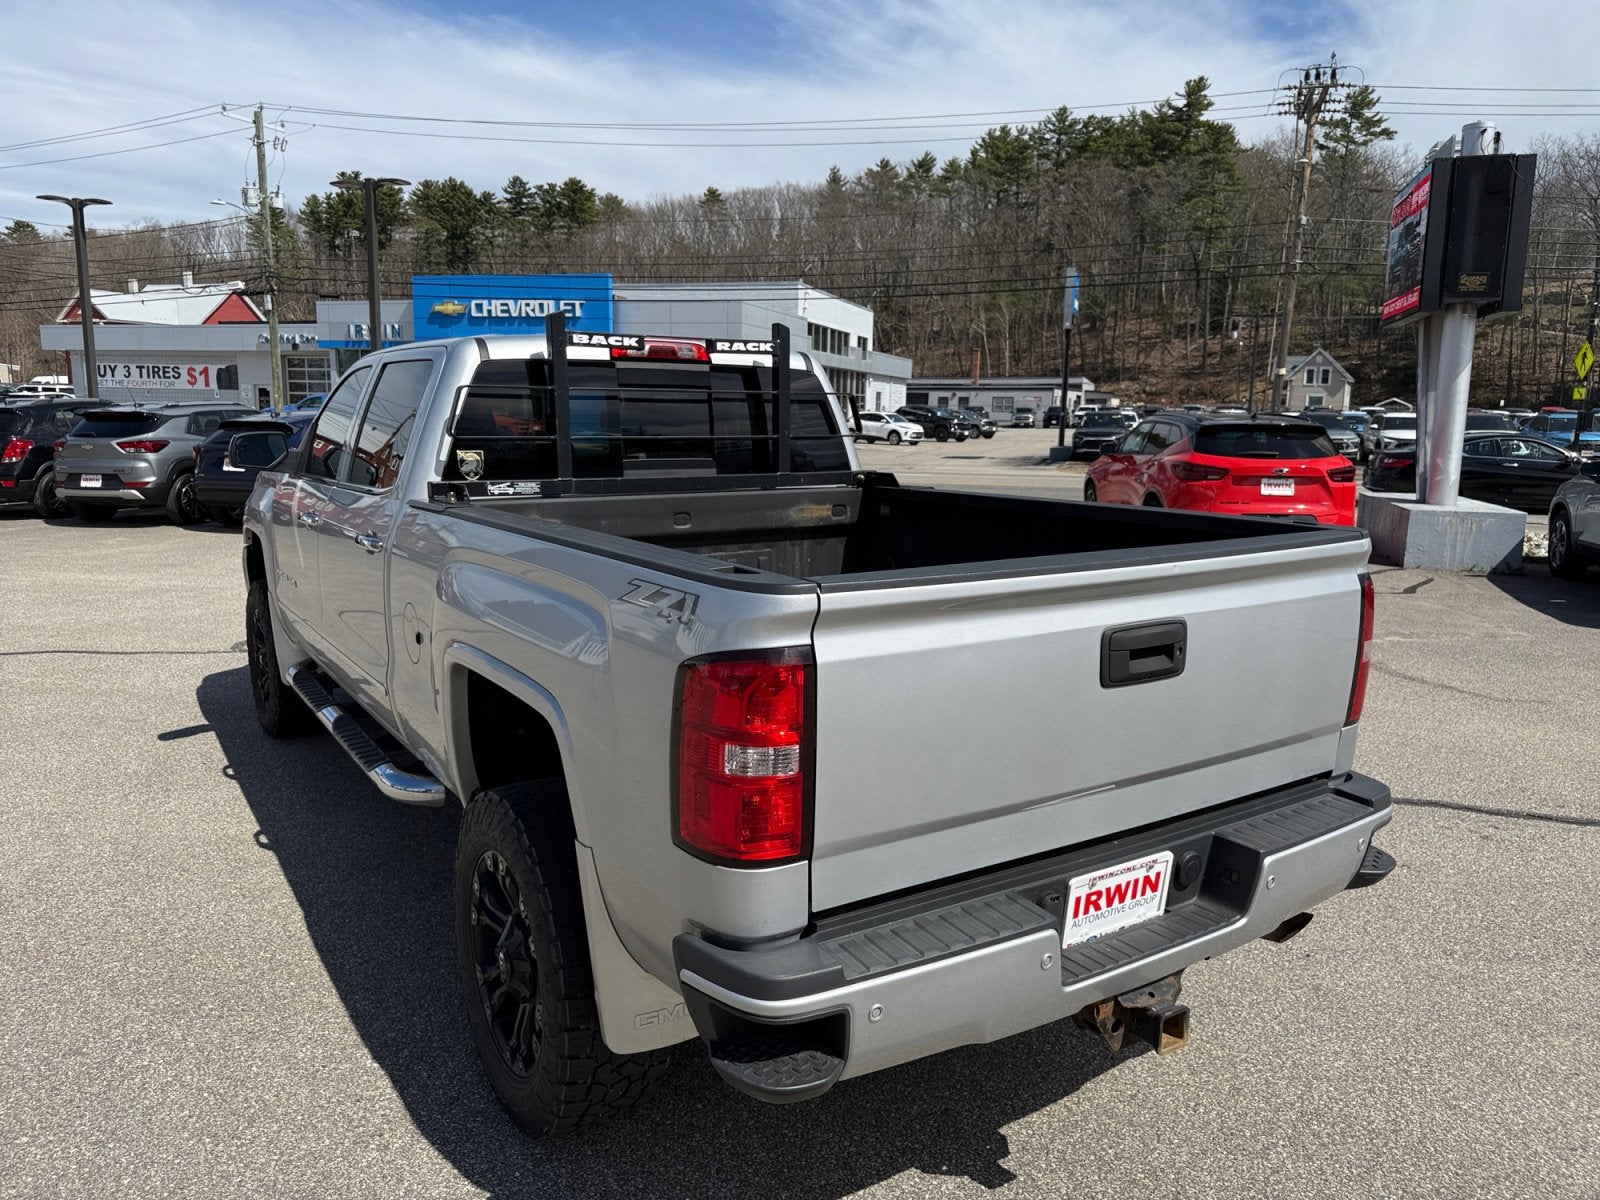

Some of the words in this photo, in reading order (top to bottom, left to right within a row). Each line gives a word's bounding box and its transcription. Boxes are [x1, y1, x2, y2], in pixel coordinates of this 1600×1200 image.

[470, 300, 585, 318] CHEVROLET
[572, 334, 639, 347] BACK
[716, 341, 774, 352] RACK
[97, 365, 117, 378] UY
[123, 365, 131, 379] 3
[136, 366, 181, 379] TIRES
[186, 365, 210, 388] $1
[127, 380, 158, 388] FOURTH
[617, 577, 700, 615] Z71
[1088, 859, 1158, 886] IRWINZONE.COM
[1072, 871, 1161, 919] IRWIN
[1071, 904, 1126, 929] AUTOMOTIVE
[1128, 894, 1157, 910] GROUP
[634, 1002, 687, 1030] GM
